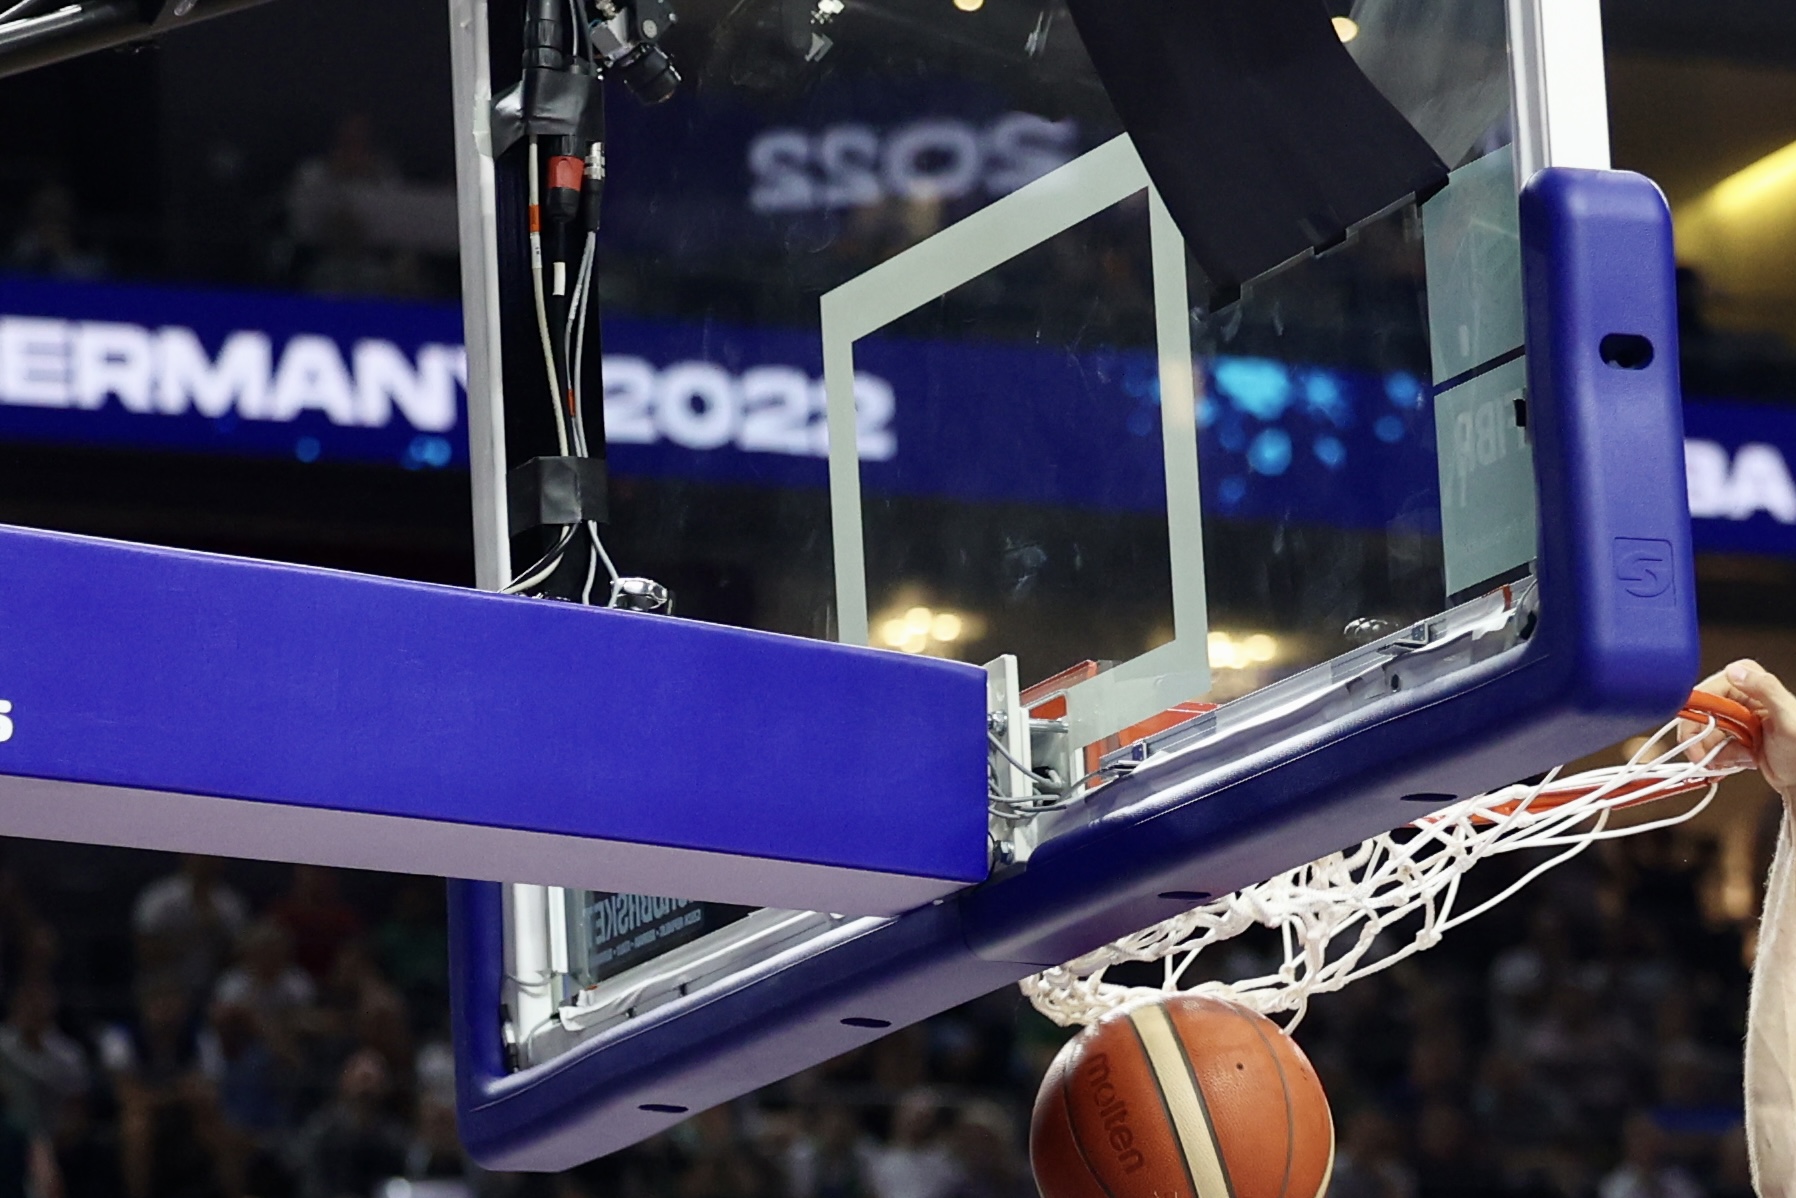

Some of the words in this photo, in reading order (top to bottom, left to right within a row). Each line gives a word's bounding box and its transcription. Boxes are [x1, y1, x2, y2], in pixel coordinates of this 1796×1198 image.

[0, 314, 467, 433] ERMAN
[601, 353, 898, 461] 2022
[1083, 1052, 1144, 1174] molten
